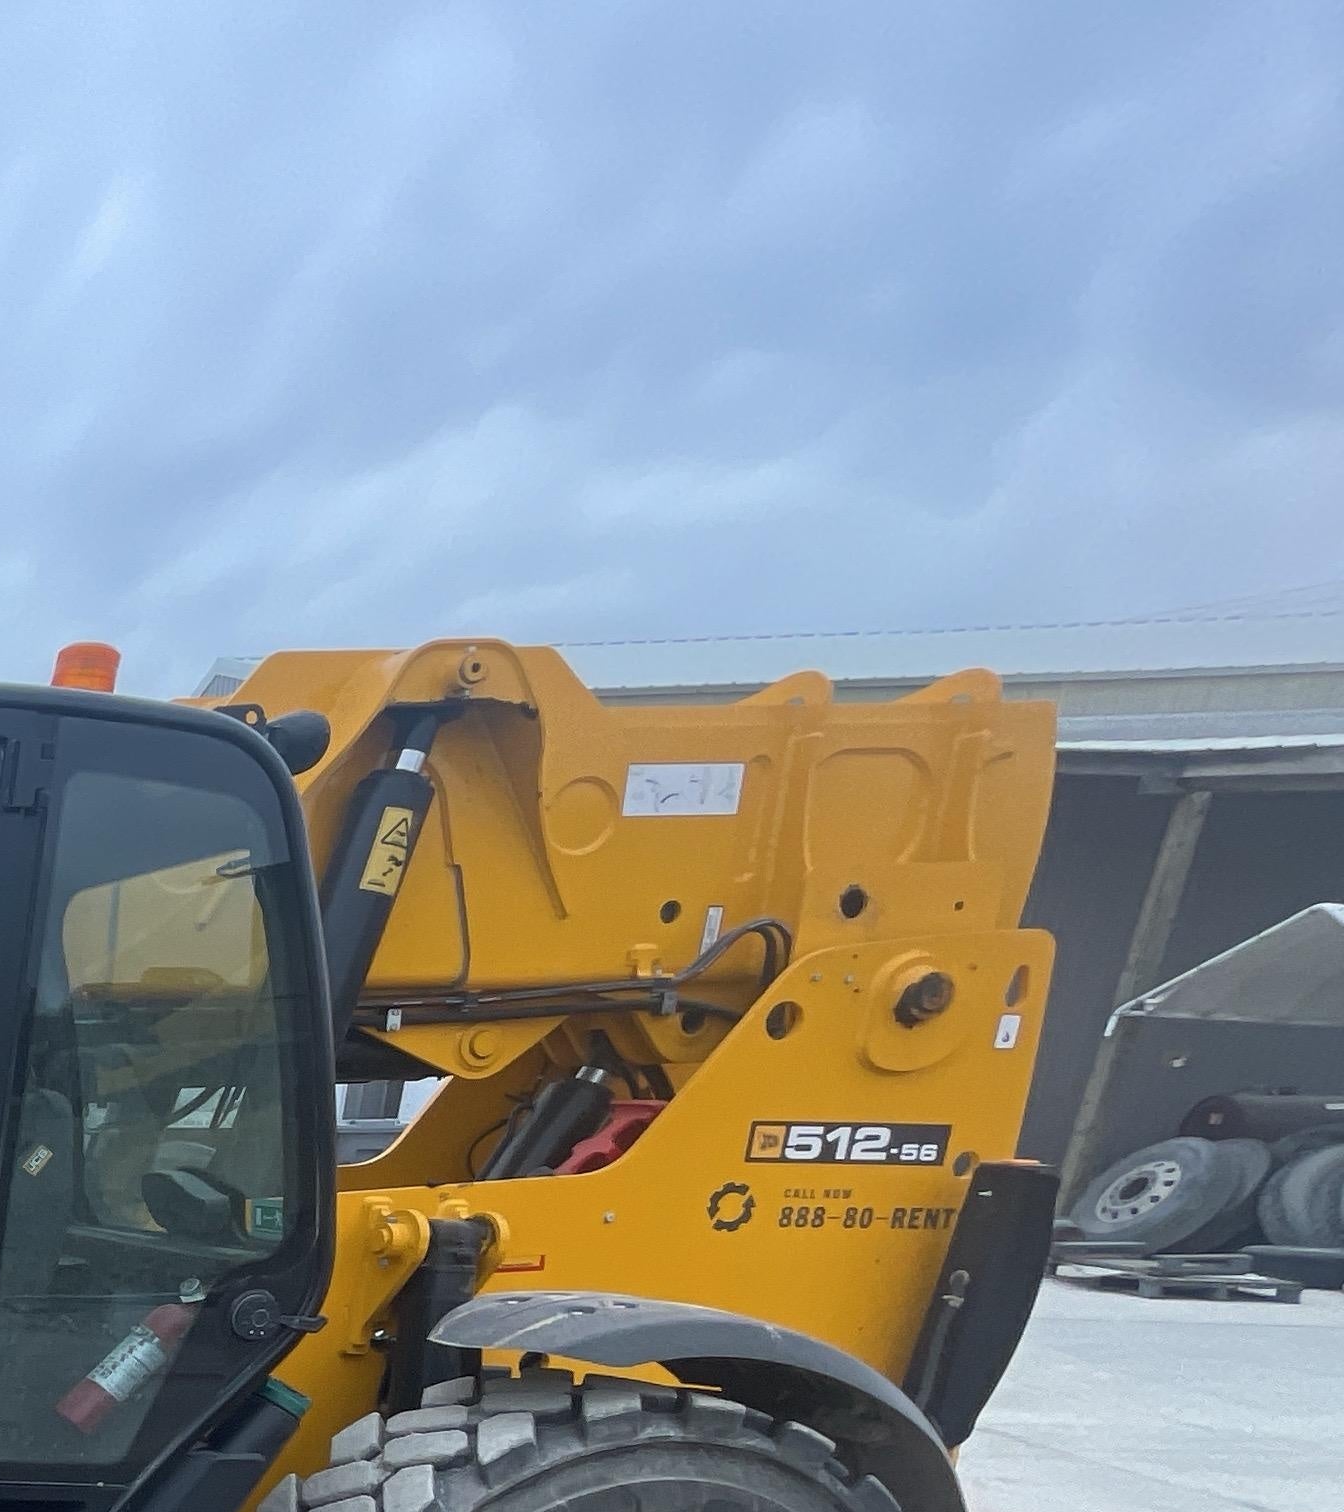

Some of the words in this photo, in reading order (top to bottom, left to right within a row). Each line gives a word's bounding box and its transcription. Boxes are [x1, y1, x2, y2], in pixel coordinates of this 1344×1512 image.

[784, 1125, 939, 1162] 512-56
[784, 1188, 816, 1200] CALL
[823, 1189, 853, 1200] NOW
[779, 1206, 957, 1230] 888-80-RENT
